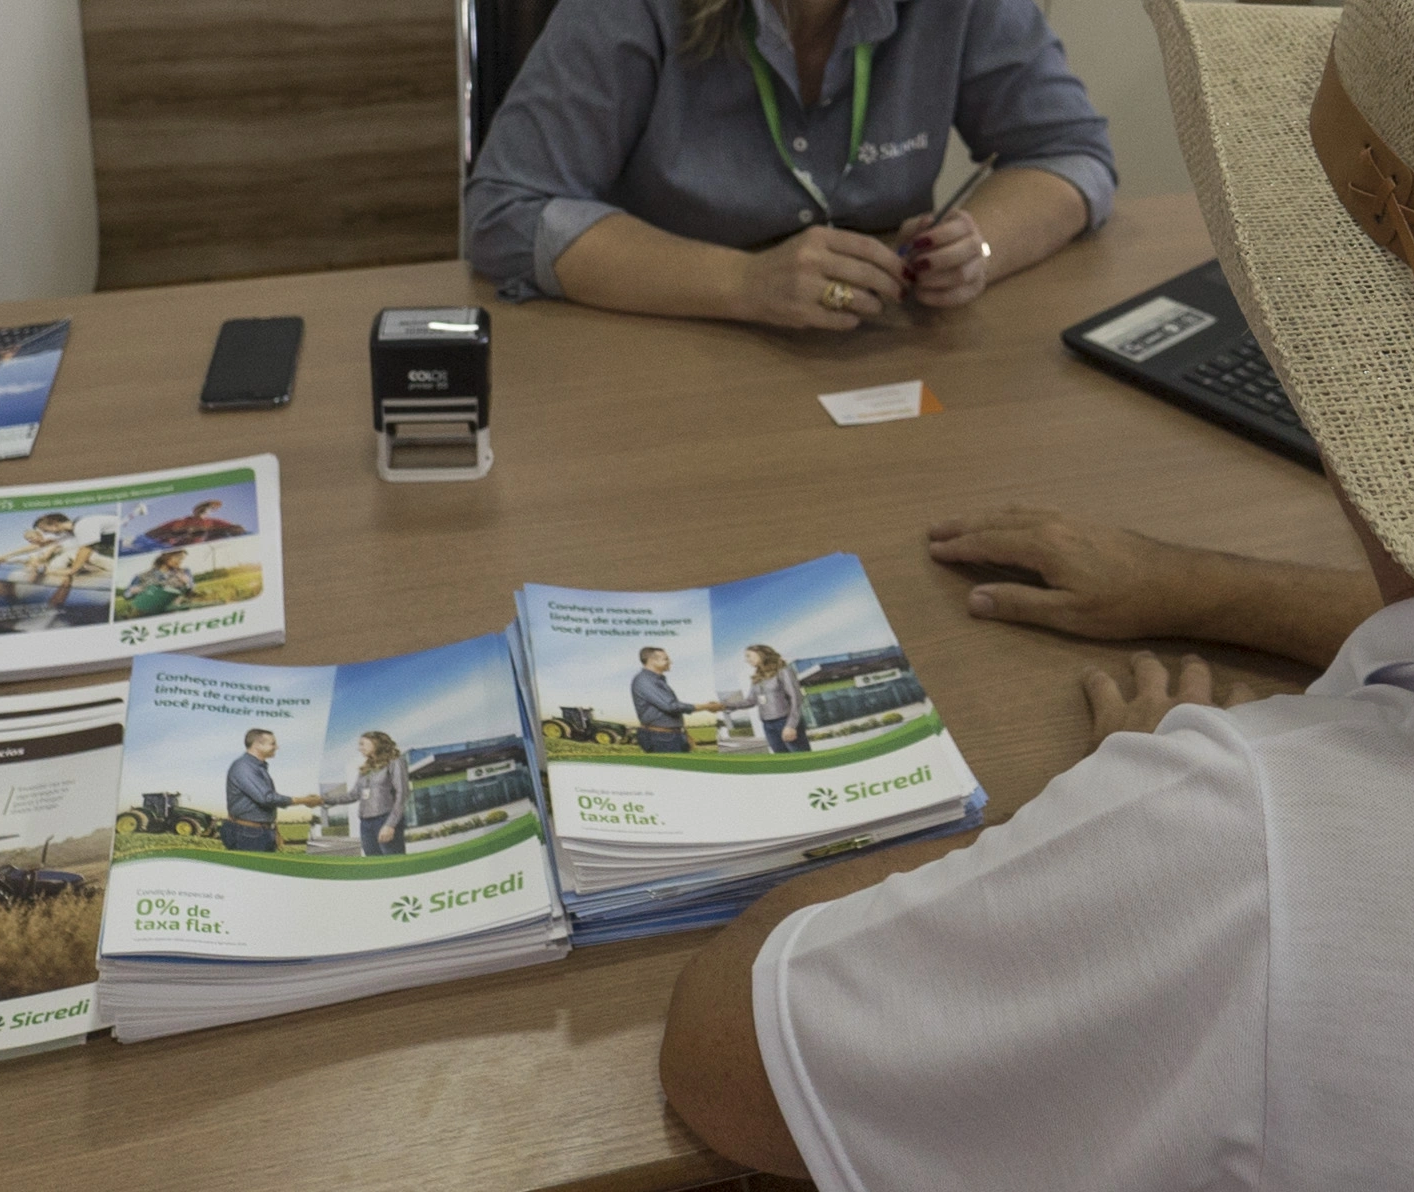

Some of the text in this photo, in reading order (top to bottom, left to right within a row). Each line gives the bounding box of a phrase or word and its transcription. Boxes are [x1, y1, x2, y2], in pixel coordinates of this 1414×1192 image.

[155, 610, 246, 639] Sicredi
[156, 671, 271, 692] Conheça nossas
[155, 684, 310, 706] linhas de crédito para
[154, 698, 294, 719] você produzir mais.
[843, 764, 933, 804] Sicredi
[577, 795, 645, 813] 0% de
[580, 811, 620, 824] taxa
[428, 871, 525, 915] Sicredi
[136, 898, 211, 918] 0% de
[135, 918, 180, 931] taxa
[9, 998, 90, 1029] Sicredi
